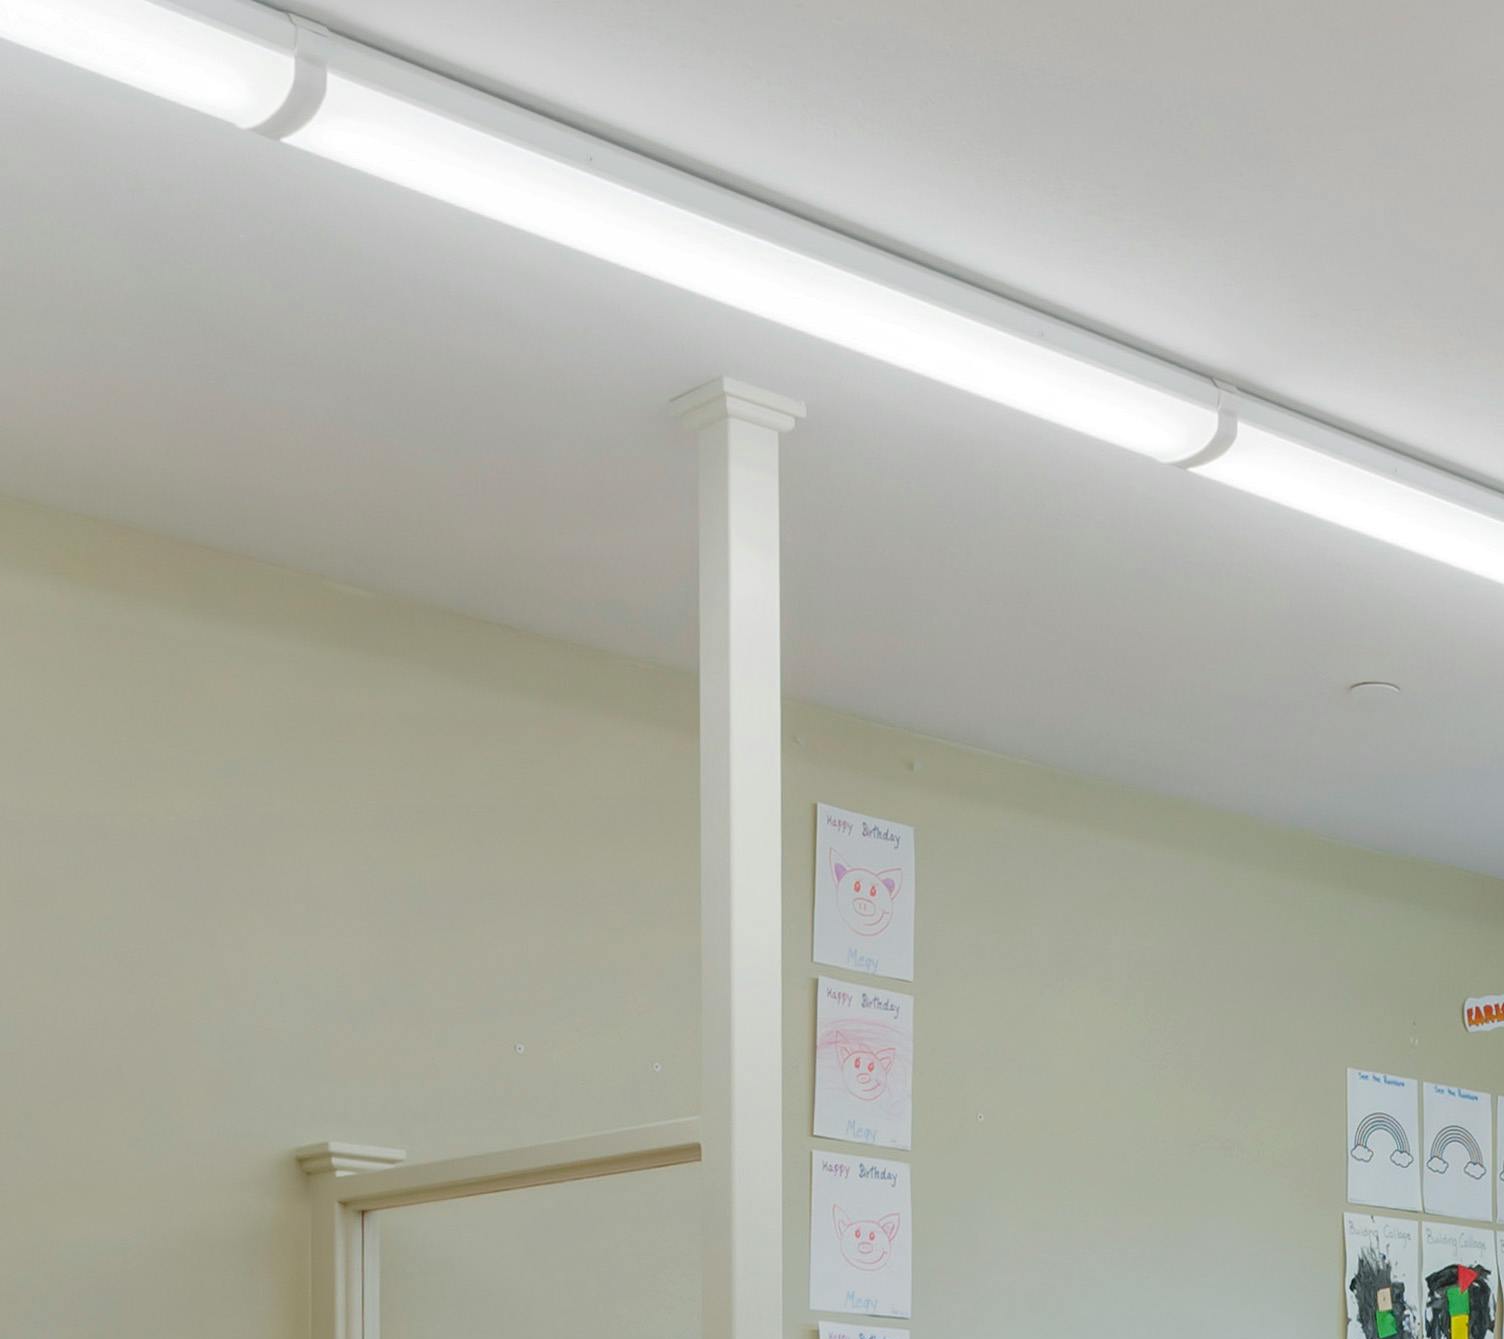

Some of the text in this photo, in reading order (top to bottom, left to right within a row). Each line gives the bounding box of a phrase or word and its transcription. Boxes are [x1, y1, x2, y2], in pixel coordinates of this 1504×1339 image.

[826, 815, 901, 850] Happy Birthday
[822, 1160, 898, 1188] Happy Birthday
